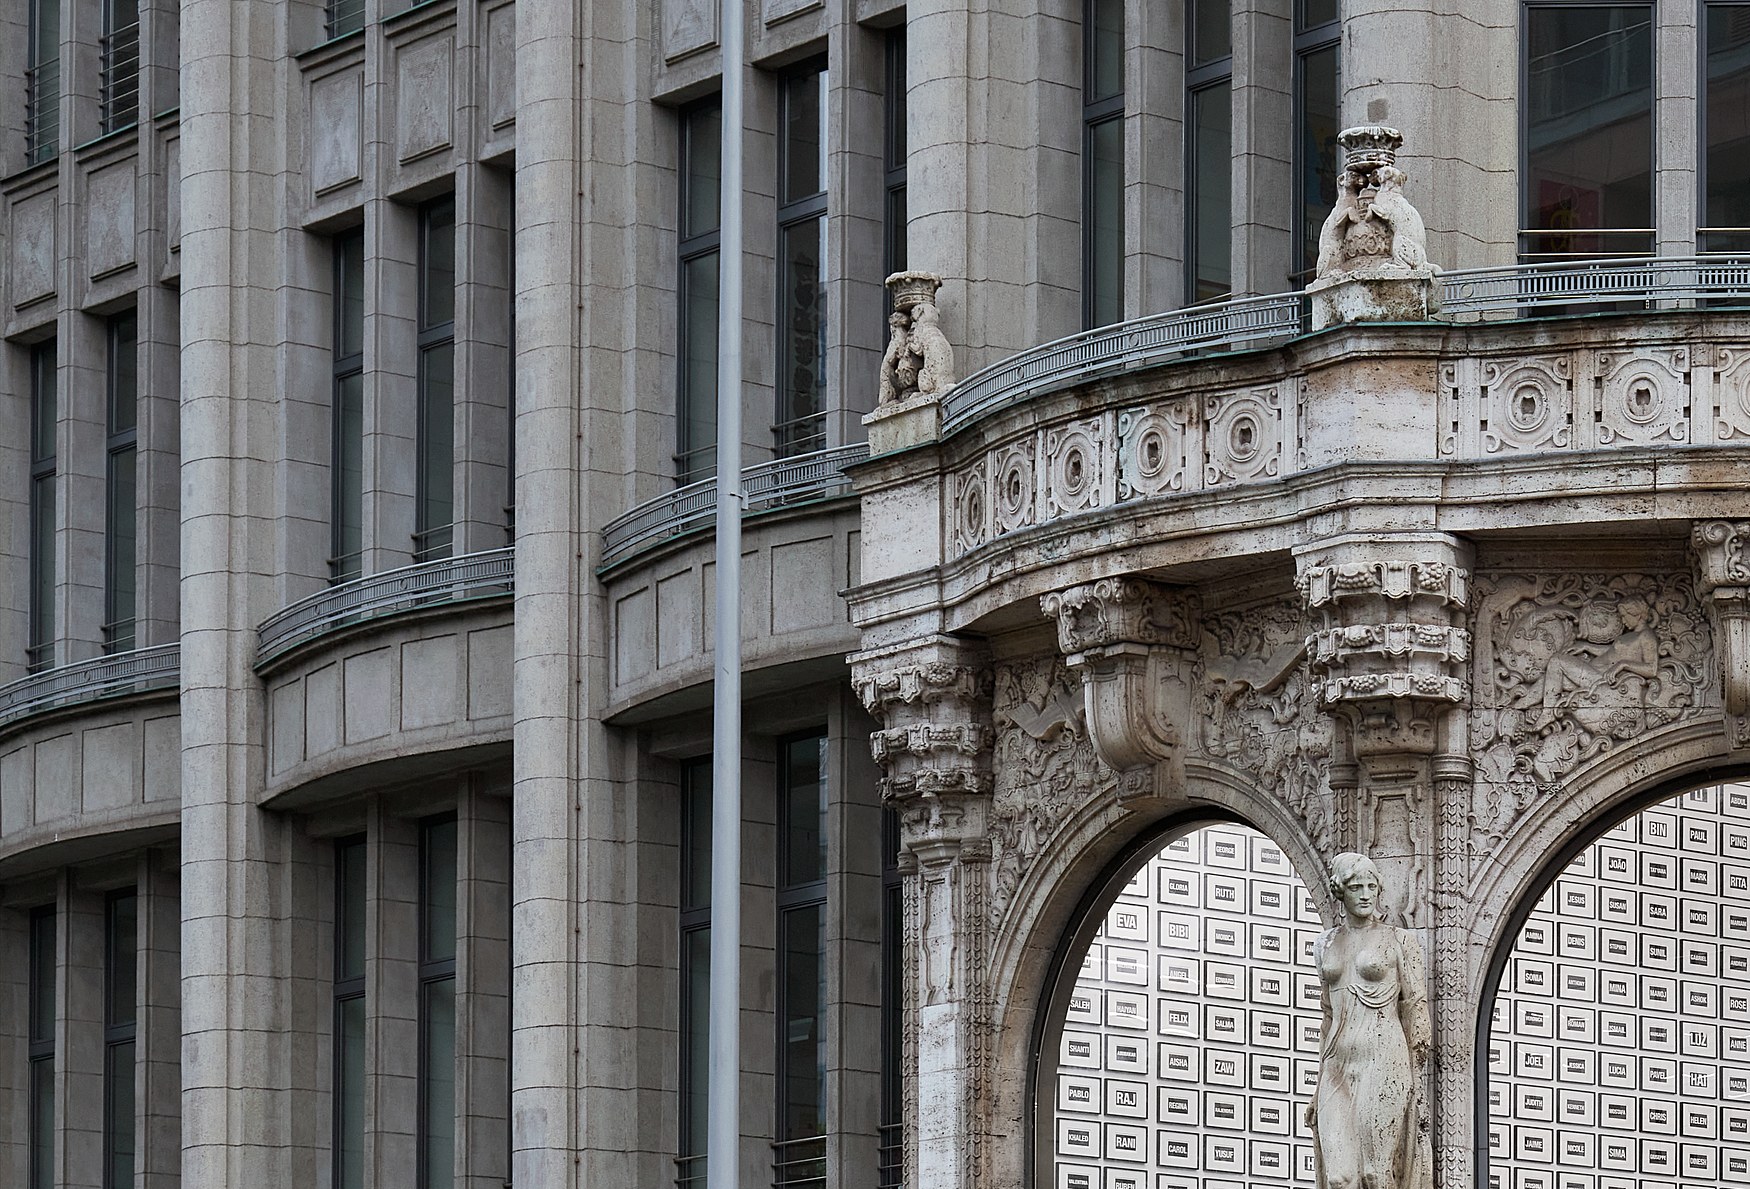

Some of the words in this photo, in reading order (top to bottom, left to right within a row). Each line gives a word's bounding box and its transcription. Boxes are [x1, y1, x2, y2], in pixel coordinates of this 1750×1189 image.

[1650, 821, 1666, 837] BIN
[1690, 829, 1705, 842] PAUL
[1730, 876, 1746, 889] RITA
[1216, 886, 1234, 900] RUTH
[1609, 901, 1626, 911] SUSAN
[1650, 906, 1666, 917] SARA
[1117, 914, 1136, 929] EVA
[1690, 912, 1707, 923] NOOR
[1170, 923, 1188, 938] BIBI
[1730, 998, 1746, 1010] ROSE
[1216, 1060, 1234, 1074] ZAW
[1117, 1091, 1136, 1106] RAJ
[1168, 1144, 1187, 1155] CAROL
